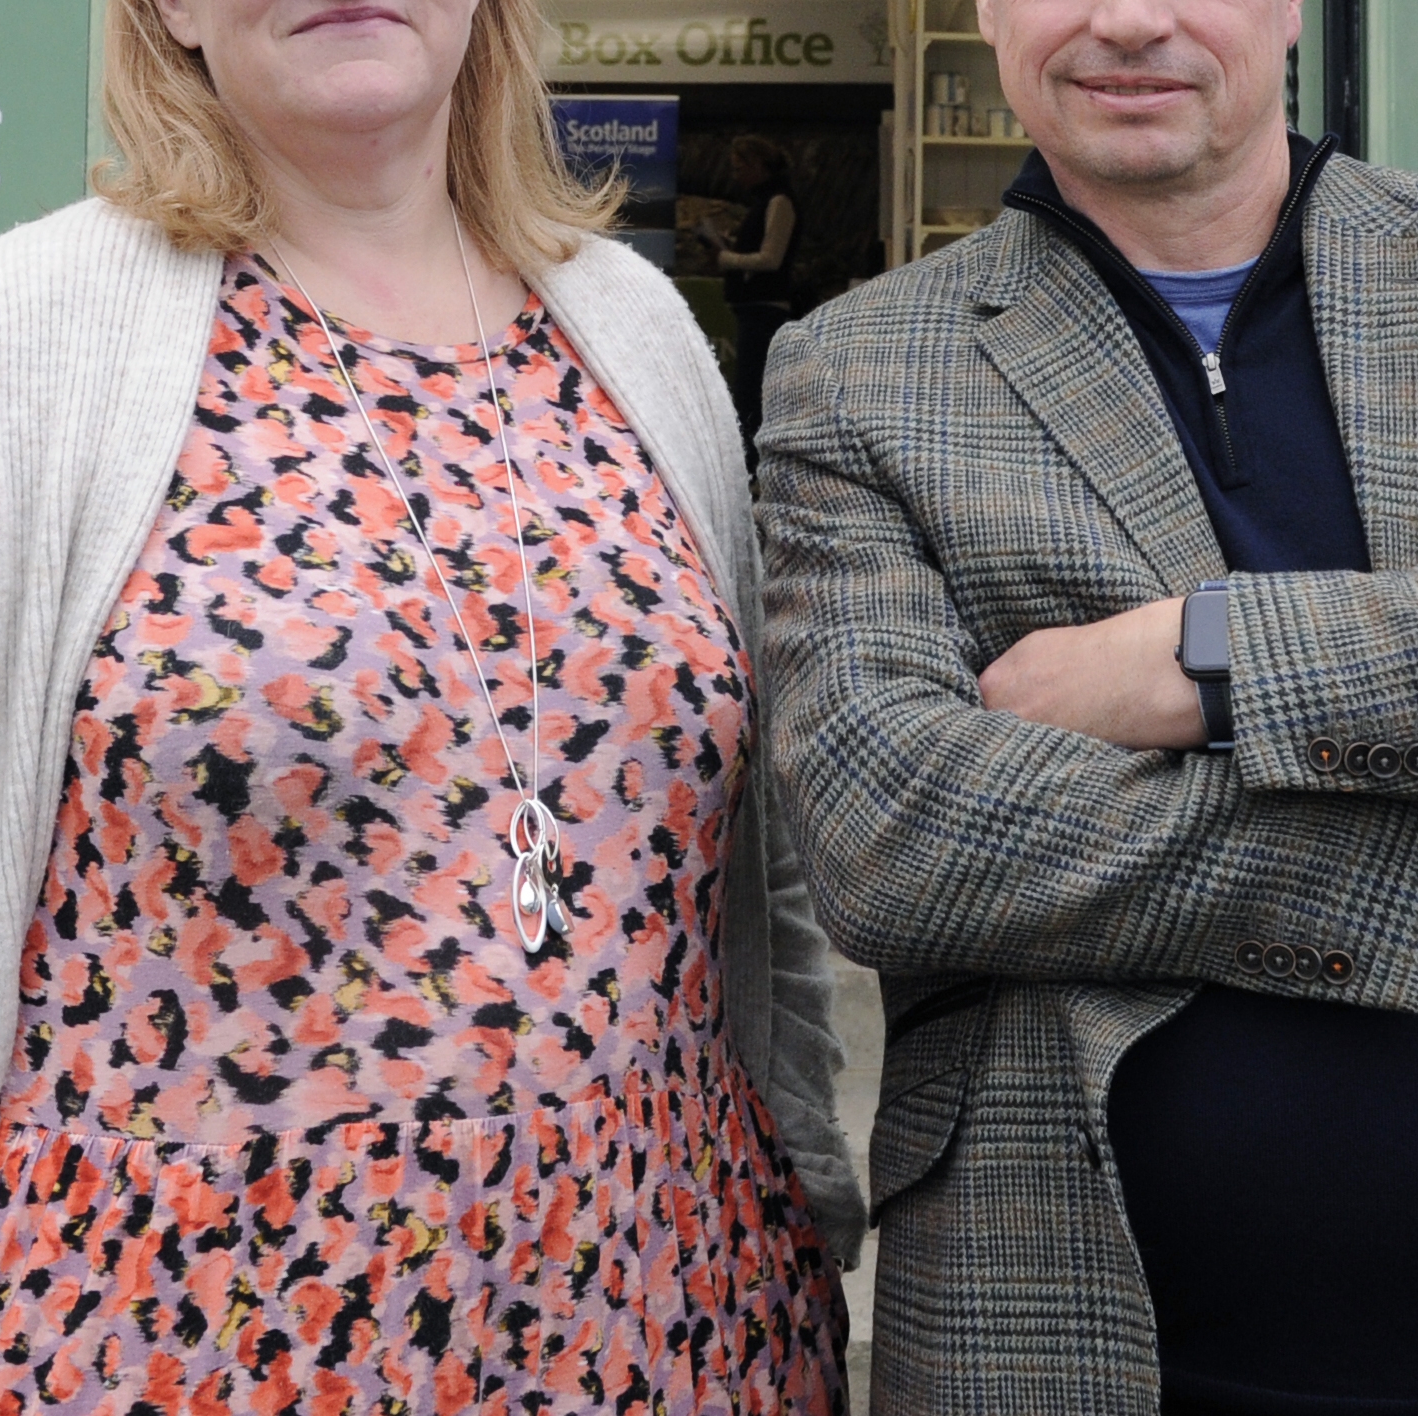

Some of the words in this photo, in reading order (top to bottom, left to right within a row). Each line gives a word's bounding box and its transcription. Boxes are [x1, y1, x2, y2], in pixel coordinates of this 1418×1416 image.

[556, 20, 662, 66] Box
[675, 16, 834, 66] Office
[566, 118, 659, 142] Scotland
